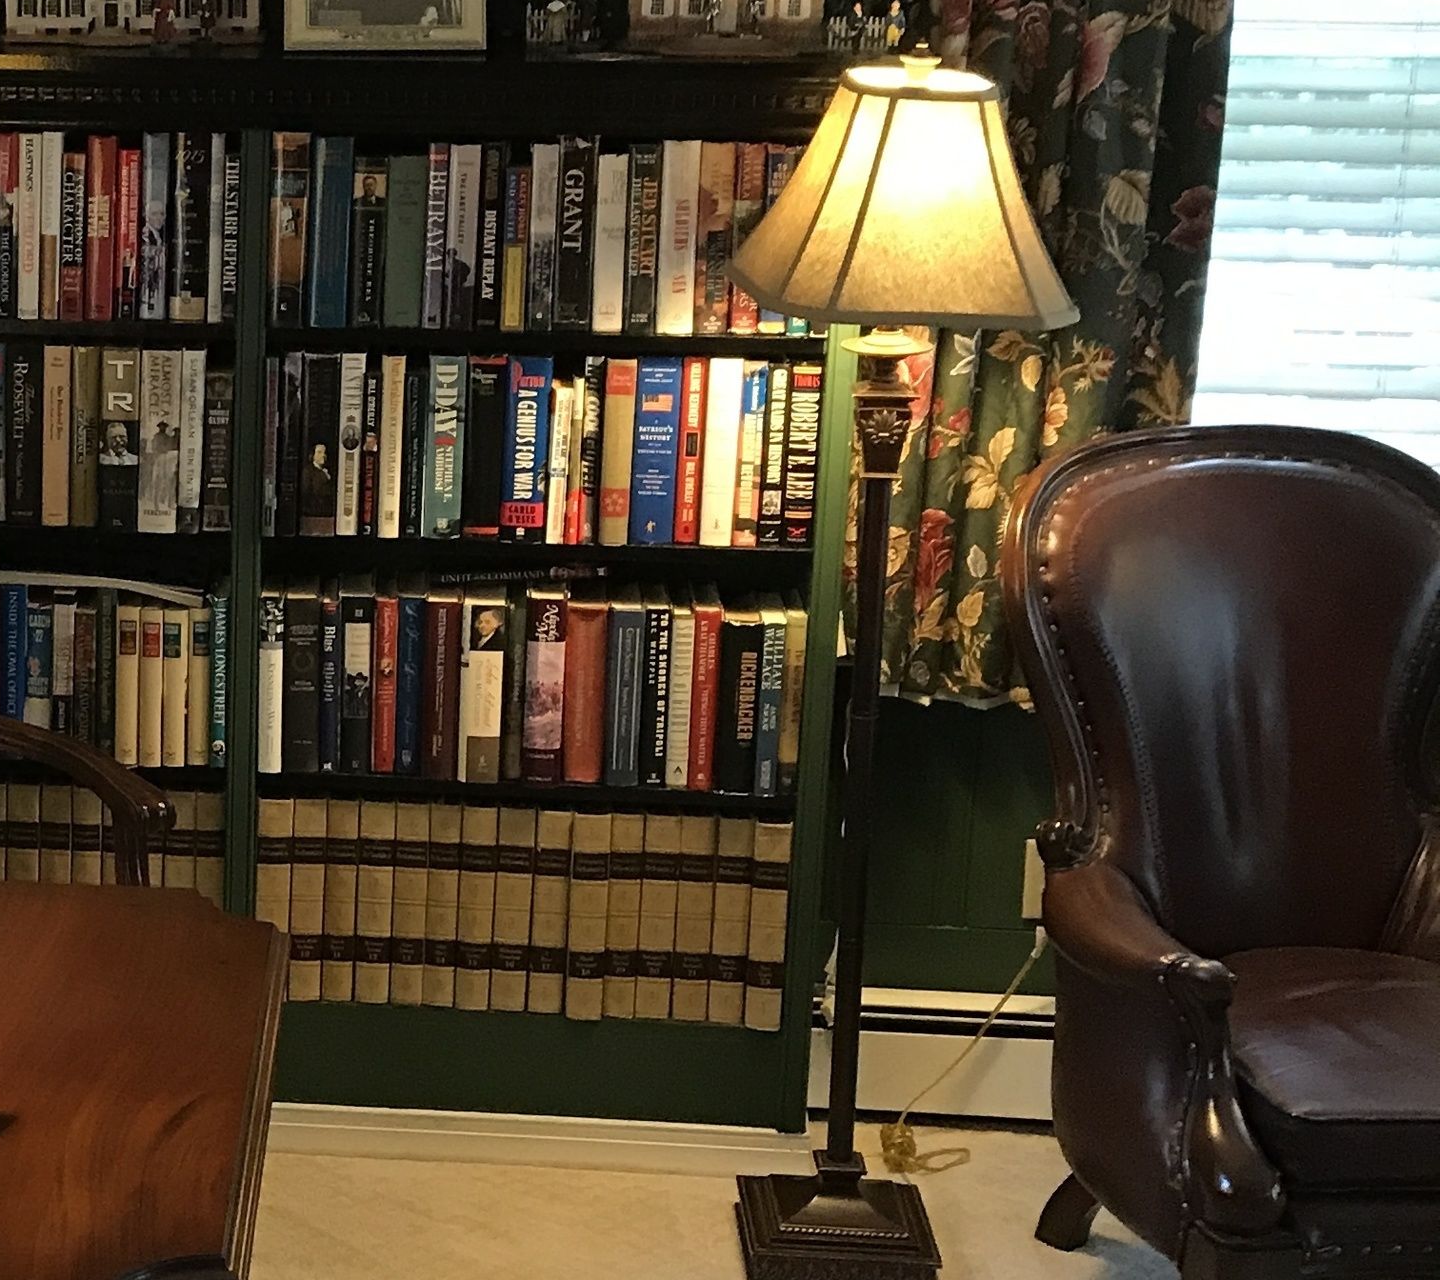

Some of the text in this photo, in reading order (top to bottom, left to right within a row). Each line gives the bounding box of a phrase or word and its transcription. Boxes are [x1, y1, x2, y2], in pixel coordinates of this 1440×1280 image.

[25, 138, 33, 192] HASTINGS
[642, 177, 657, 209] JEB
[62, 171, 75, 263] CHARACTER
[74, 184, 83, 263] QUESTION OF
[222, 159, 240, 294] THE STARR REPORT
[426, 170, 447, 273] BETRAYAL
[483, 209, 497, 255] DISTANT
[506, 201, 515, 240] CUSTER
[561, 169, 585, 254] GRANT
[631, 202, 640, 225] LAST
[0, 232, 11, 302] THE GLORIOUS
[640, 215, 655, 277] STUART
[481, 259, 495, 301] REPLAY
[107, 360, 134, 380] T
[150, 355, 160, 417] MIRACLE
[161, 356, 171, 417] ALMOST A
[189, 358, 198, 393] SUSAN
[367, 379, 377, 395] BILL
[390, 380, 401, 414] Jenkins
[391, 359, 402, 379] Dan
[13, 362, 29, 440] ROOSEVELT
[107, 392, 134, 412] R
[188, 396, 196, 438] ORLEAN
[434, 364, 459, 438] D-DAY
[766, 368, 788, 485] GREAT RAIDS IN HISTORY
[434, 445, 444, 494] AMBROSE
[444, 445, 454, 492] STEPHEN
[512, 389, 538, 500] A GENIUS FOR WAR
[785, 392, 820, 500] ROBERT E. LEE
[7, 591, 18, 715] INSIDE THE OVAL OFFICE
[214, 607, 226, 726] JAMES LONGSTREET
[761, 628, 775, 690] WALLACE
[771, 628, 785, 690] WILLIAM
[655, 613, 668, 757] TO THE SHORES OF TRIPOLI
[736, 651, 758, 740] RICKENBACKER
